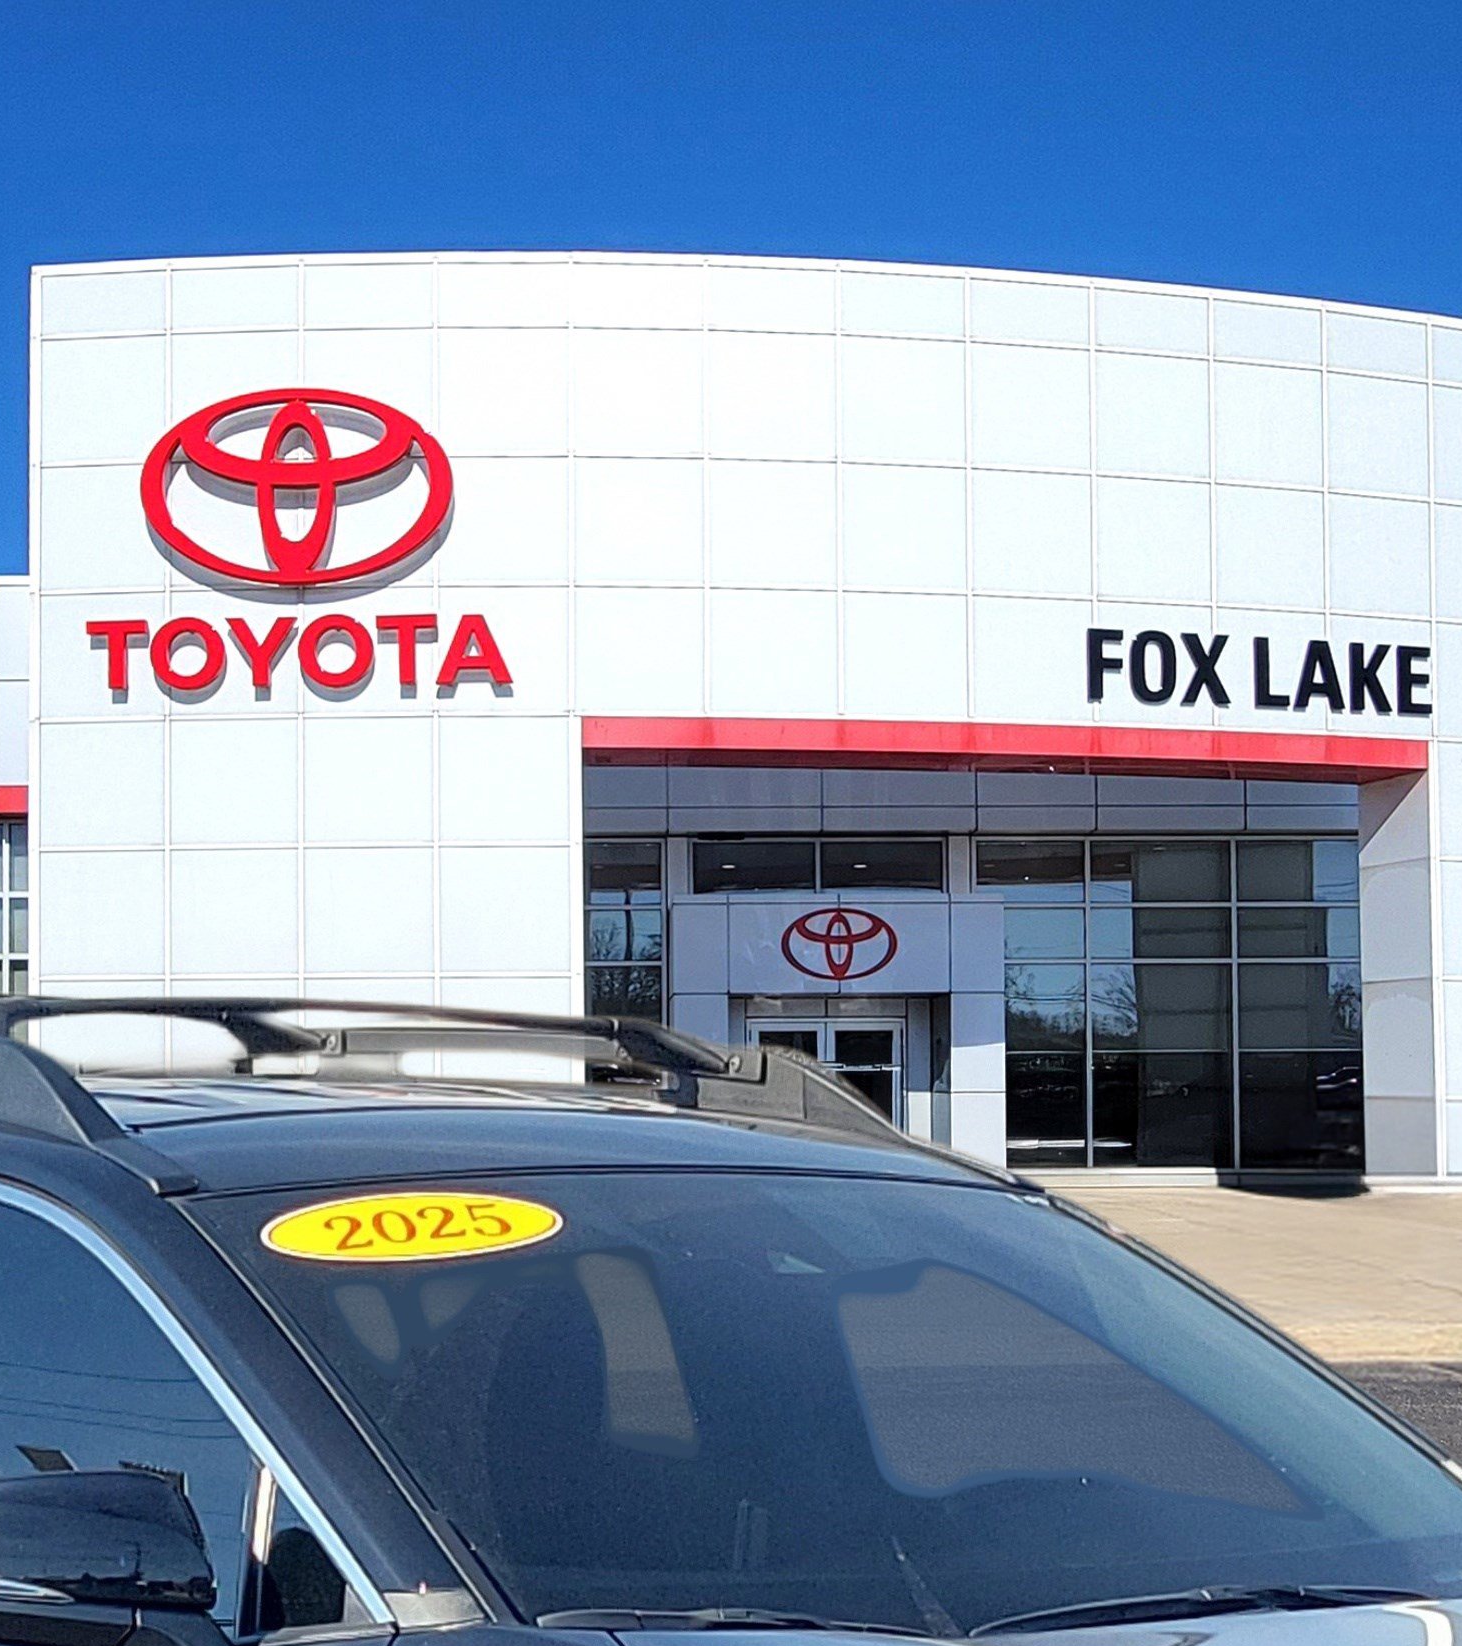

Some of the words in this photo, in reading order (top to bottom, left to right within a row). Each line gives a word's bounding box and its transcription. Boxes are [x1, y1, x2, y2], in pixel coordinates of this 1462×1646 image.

[86, 614, 512, 691] TOYOTA
[1087, 628, 1231, 706] FOX
[1254, 637, 1433, 716] LAKE
[323, 1203, 512, 1251] 2025
